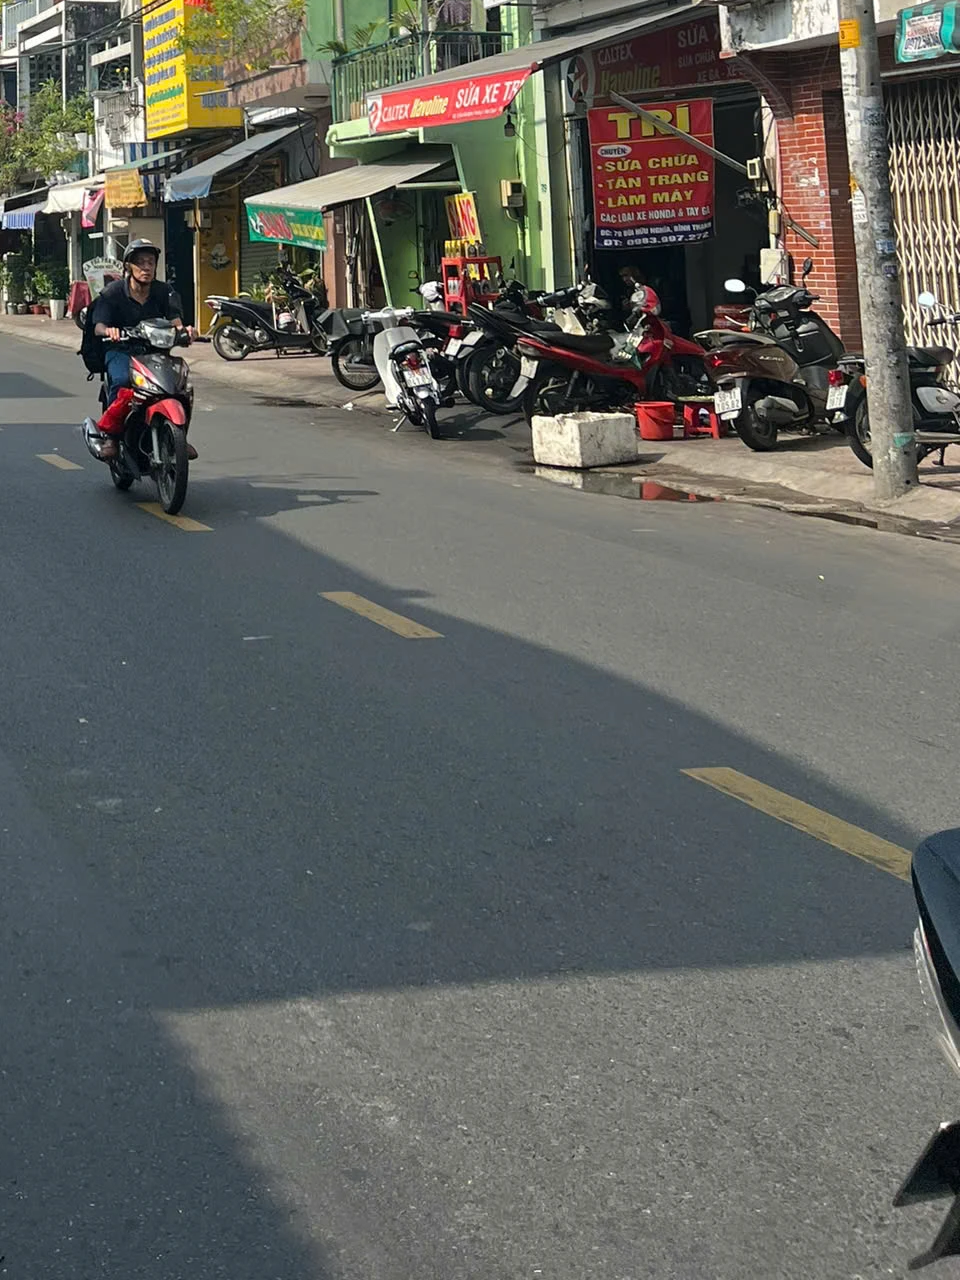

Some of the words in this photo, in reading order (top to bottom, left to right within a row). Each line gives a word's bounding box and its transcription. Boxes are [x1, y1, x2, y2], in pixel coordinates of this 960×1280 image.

[598, 43, 633, 65] CALTEX
[600, 64, 660, 95] Havoline
[381, 103, 410, 122] CALTEX
[410, 94, 449, 118] Havoline
[455, 81, 480, 109] SỬA
[481, 83, 501, 104] XE
[608, 103, 690, 139] TRÍ
[604, 158, 642, 171] SỬA
[648, 154, 699, 169] CHỮA
[647, 171, 709, 186] TRANG
[607, 191, 646, 208] LÀM
[636, 211, 647, 220] XE
[648, 208, 676, 220] HONDA
